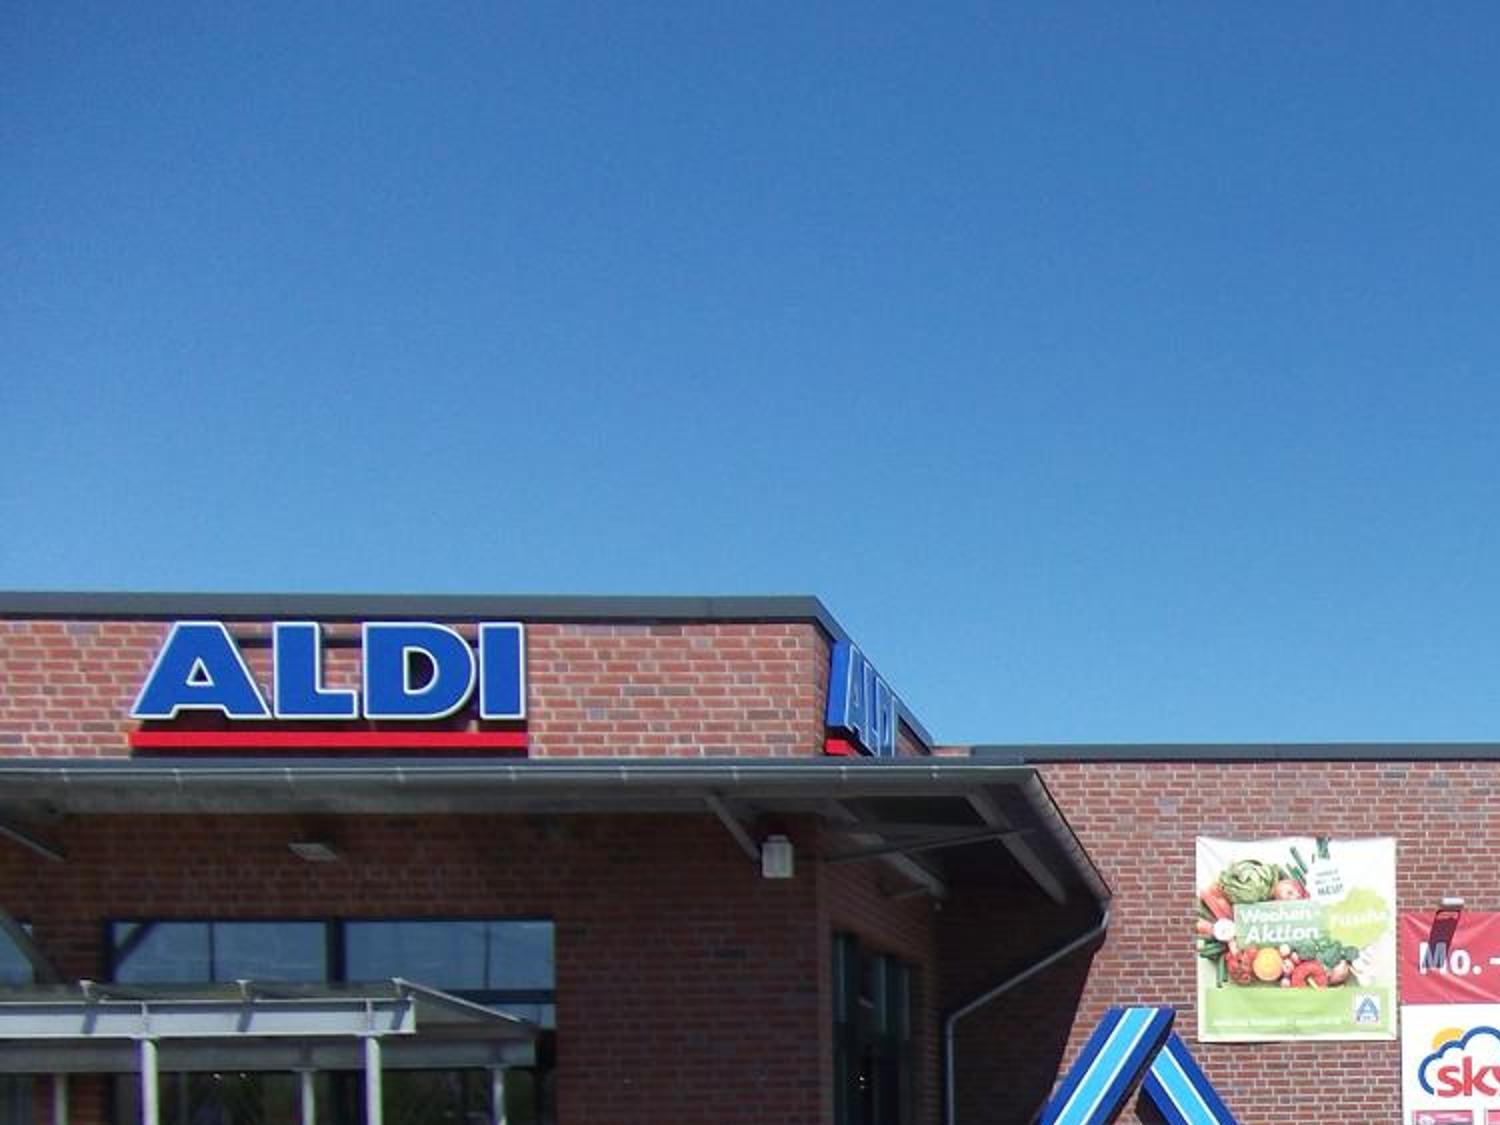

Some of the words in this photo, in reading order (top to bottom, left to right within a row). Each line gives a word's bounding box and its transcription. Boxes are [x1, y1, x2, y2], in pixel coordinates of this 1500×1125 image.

[131, 620, 526, 720] ALDI
[1244, 924, 1321, 946] Aktion
[1419, 941, 1482, 975] Mo.
